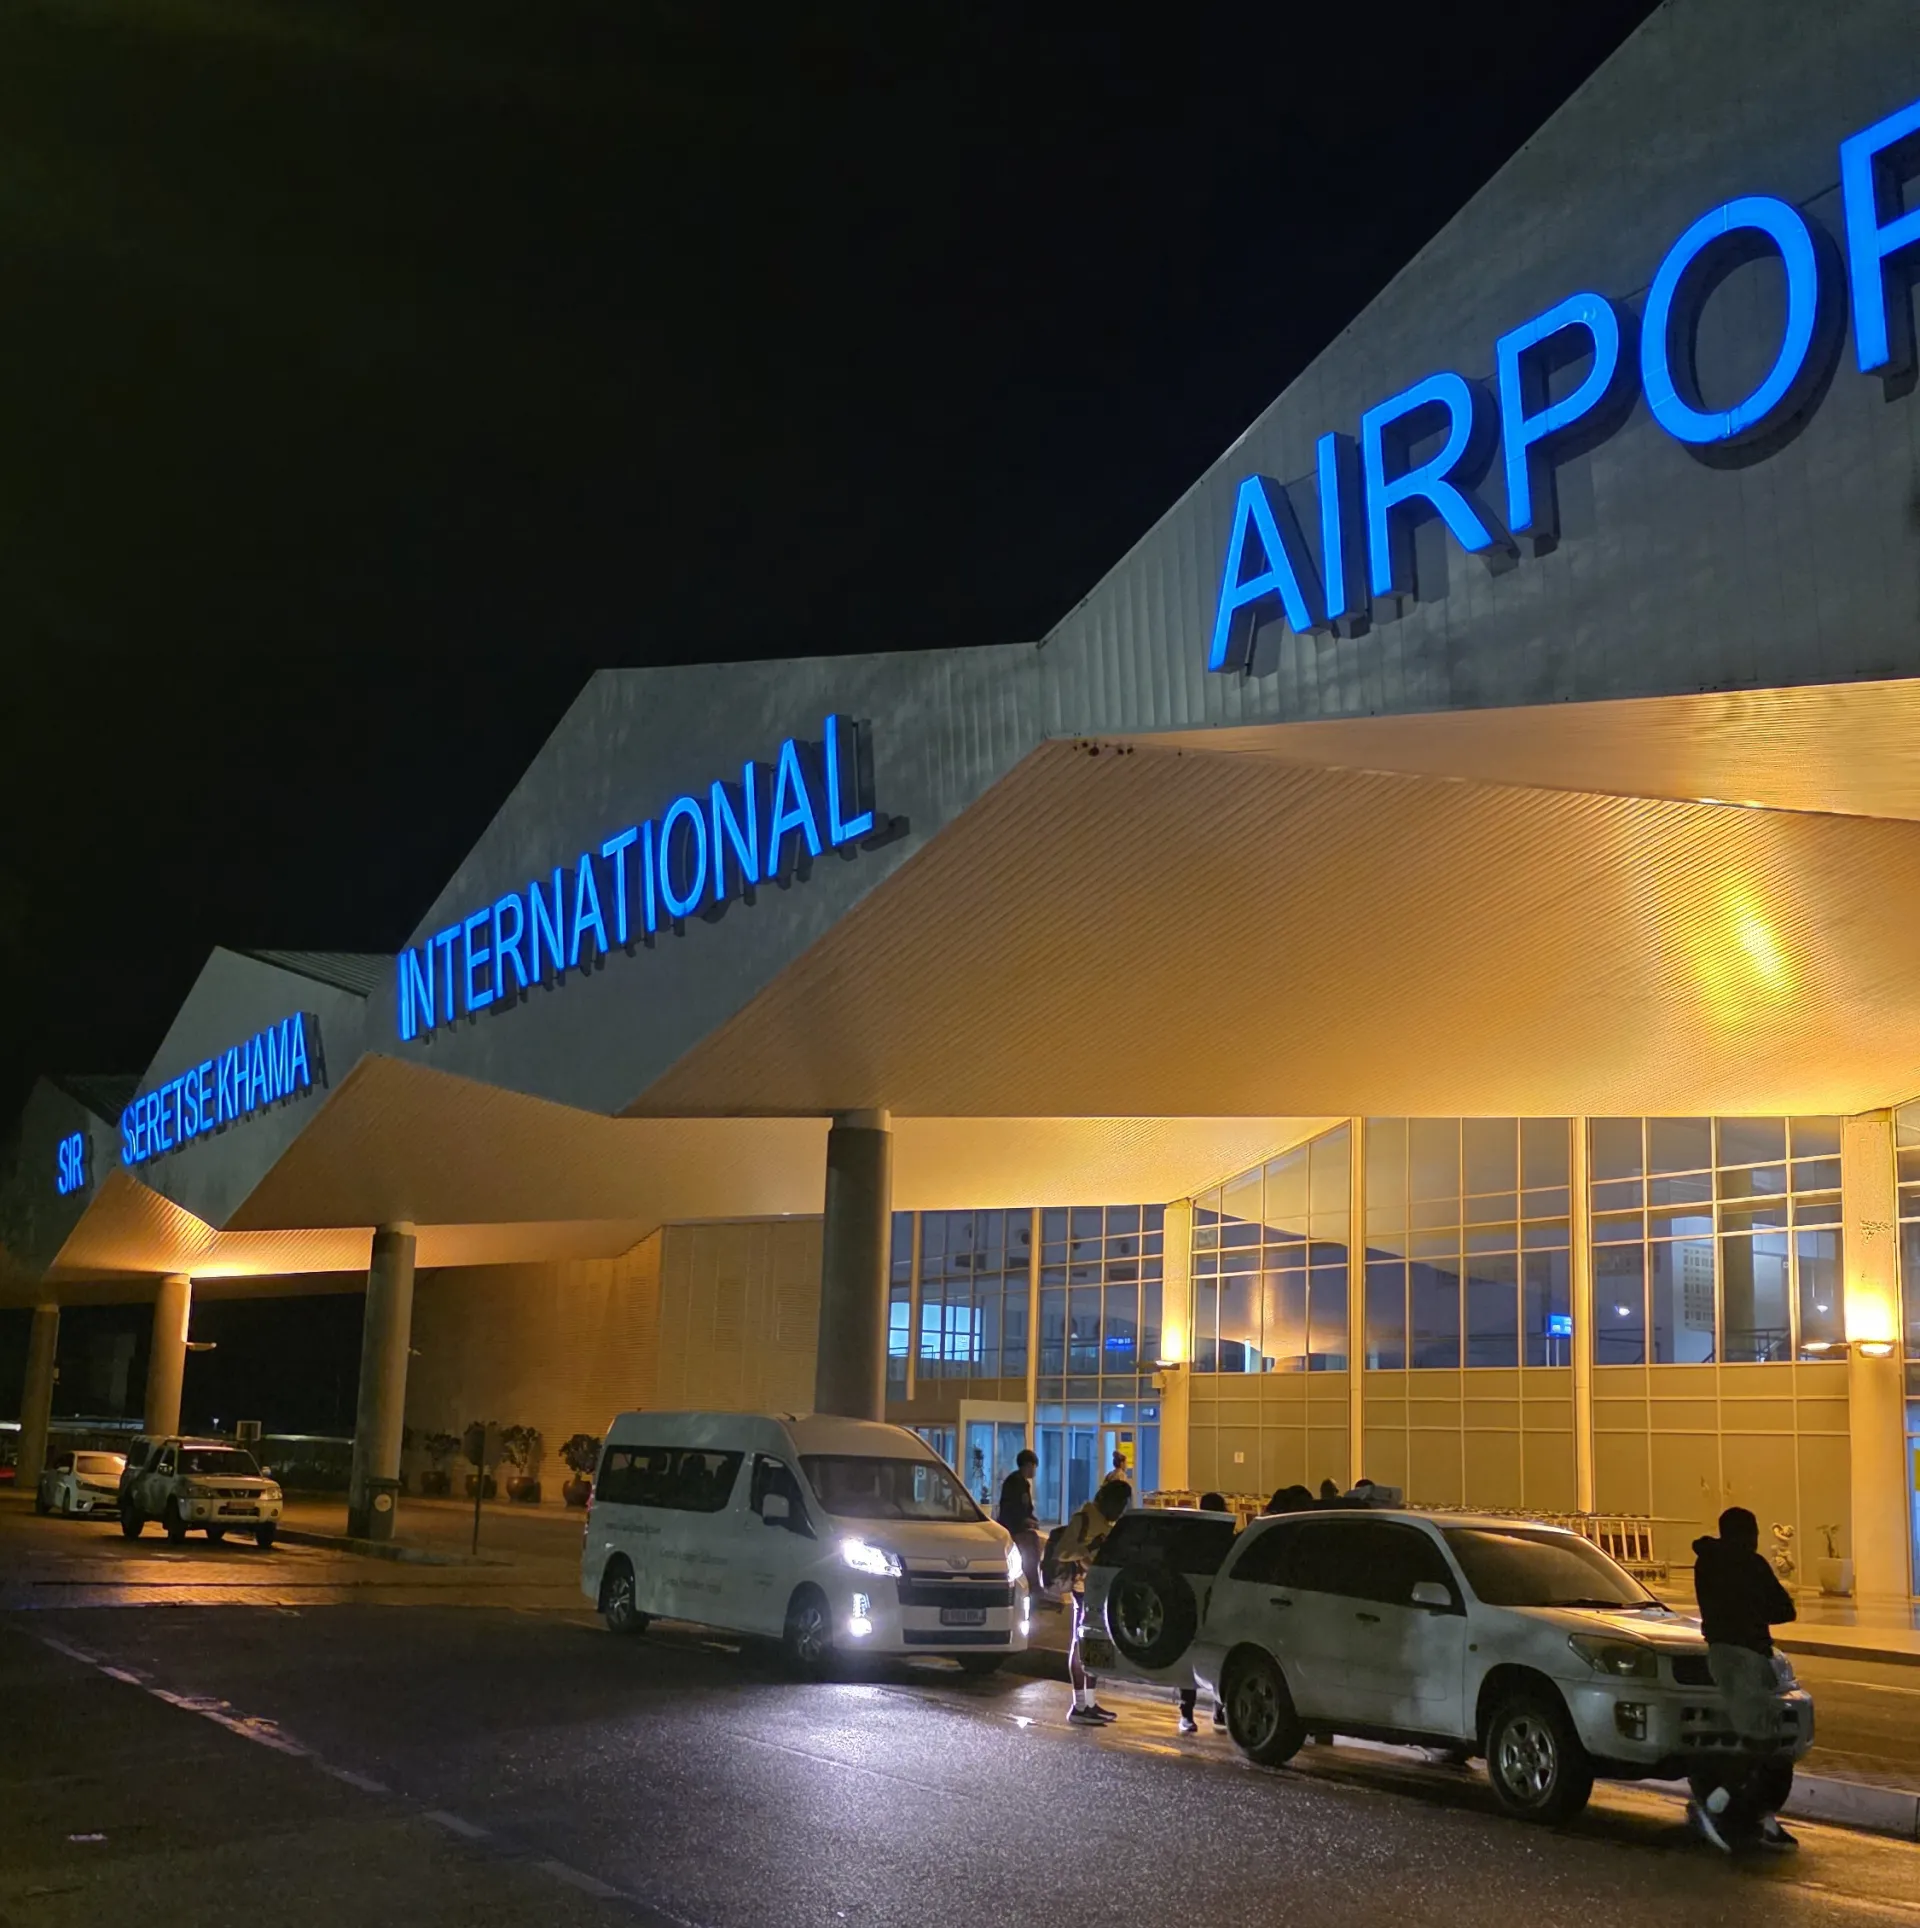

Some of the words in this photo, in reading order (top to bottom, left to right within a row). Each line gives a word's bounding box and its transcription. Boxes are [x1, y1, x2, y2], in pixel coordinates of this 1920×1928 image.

[400, 714, 874, 1041] INTERNATIONAL
[57, 1131, 85, 1196] SIR
[119, 1058, 216, 1166] SERETSE
[215, 1011, 312, 1122] KHAMA
